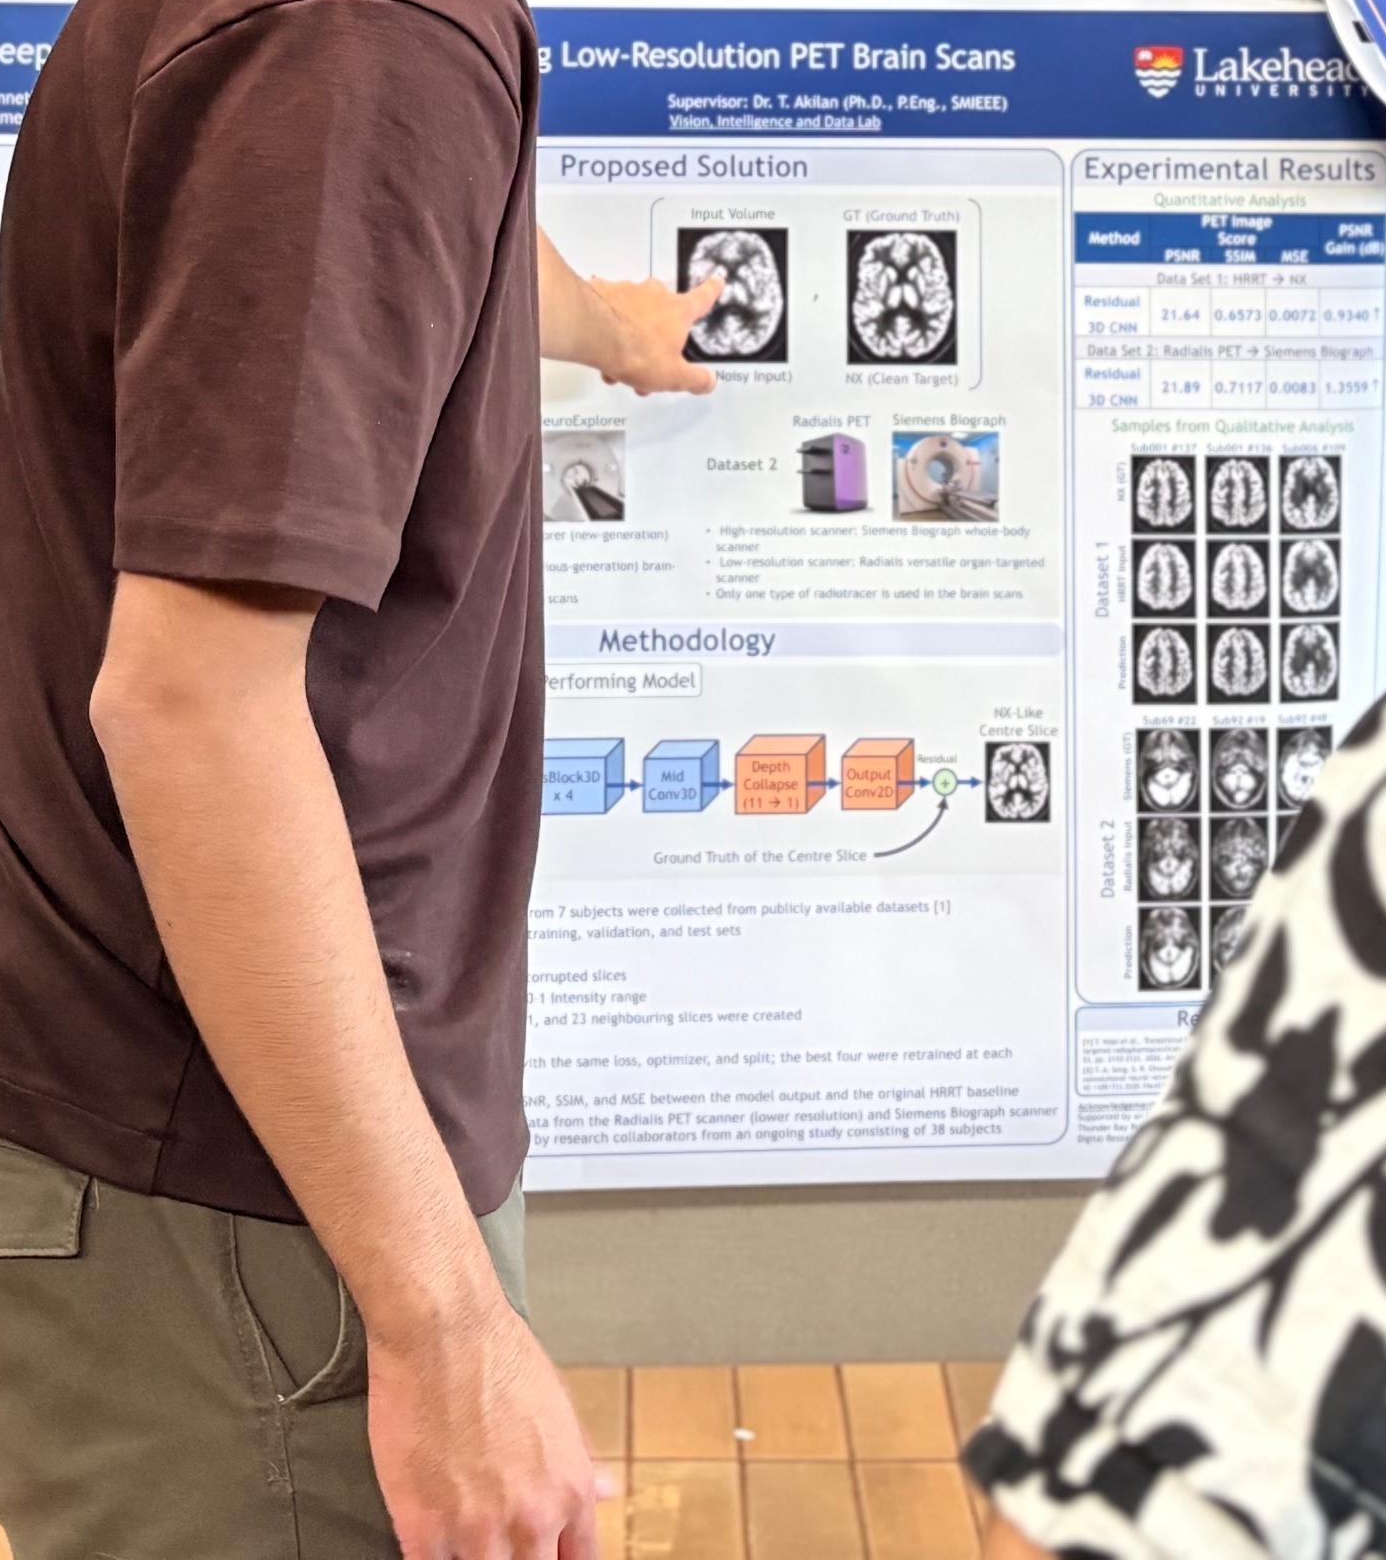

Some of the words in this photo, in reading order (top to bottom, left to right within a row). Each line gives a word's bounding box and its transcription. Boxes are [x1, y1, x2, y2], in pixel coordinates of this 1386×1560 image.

[561, 40, 781, 69] Low-Resolution
[790, 41, 845, 70] PET
[852, 41, 927, 70] Brain
[935, 42, 1016, 71] Scans
[1195, 83, 1371, 98] UNIVERSITY
[667, 93, 748, 112] Supervisor:
[752, 93, 773, 109] Dr.
[776, 93, 790, 109] T.
[793, 93, 839, 110] Akilan
[842, 93, 893, 112] (Ph.D.,
[896, 94, 947, 113] P.Eng.,
[950, 94, 1008, 112] SMIEEE)
[669, 114, 714, 130] Vision,
[717, 114, 793, 130] Intelligence
[796, 115, 821, 130] and
[824, 115, 854, 130] Data
[857, 115, 882, 131] Lab
[560, 153, 687, 183] Proposed
[697, 153, 808, 178] Solution
[1084, 156, 1269, 184] Experimental
[1278, 157, 1376, 182] Results
[1152, 191, 1245, 209] Quantitative
[1248, 192, 1307, 210] Analysis
[690, 207, 725, 222] Input
[727, 207, 776, 220] Volume
[842, 208, 862, 222] GT
[865, 208, 918, 223] (Ground
[920, 208, 961, 224] Truth)
[1201, 213, 1229, 228] PET
[1231, 214, 1273, 231] Image
[1088, 231, 1140, 245] Method
[1217, 230, 1257, 246] Score
[1338, 223, 1373, 237] PSNR
[1164, 248, 1200, 262] PSNR
[1324, 240, 1356, 255] Gain
[1225, 249, 1256, 263] SSIM
[1281, 249, 1308, 263] MSE
[845, 371, 863, 385] NX
[867, 371, 909, 387] (Clean
[913, 371, 959, 388] Target)
[791, 414, 843, 428] Radialis
[846, 414, 871, 428] PET
[891, 412, 946, 426] Siemens
[949, 412, 1007, 429] Biograph
[1111, 418, 1172, 435] Samples
[1175, 418, 1210, 433] from
[1214, 418, 1296, 435] Qualitative
[1298, 419, 1355, 435] Analysis
[706, 456, 763, 471] Dataset
[768, 456, 778, 471] 2
[598, 627, 776, 657] Methodology
[544, 672, 633, 698] erforming
[641, 671, 695, 689] Model
[978, 723, 1024, 737] Centre
[1027, 723, 1059, 737] Slice
[751, 759, 792, 776] Depth
[845, 767, 892, 783] Output
[659, 770, 686, 784] Mid
[742, 775, 799, 793] Collapse
[647, 787, 698, 802] Conv3D
[844, 785, 895, 800] Conv2D
[652, 850, 702, 865] Ground
[705, 849, 740, 864] Truth
[743, 849, 758, 863] of
[761, 849, 784, 863] the
[786, 848, 833, 863] Centre
[835, 848, 867, 862] Slice
[557, 904, 567, 919] 7
[569, 904, 624, 921] subjects
[626, 906, 660, 917] were
[662, 903, 723, 917] collected
[726, 902, 757, 916] from
[760, 901, 811, 918] publicly
[814, 900, 873, 914] available
[875, 900, 930, 913] datasets
[933, 898, 951, 916] [1]
